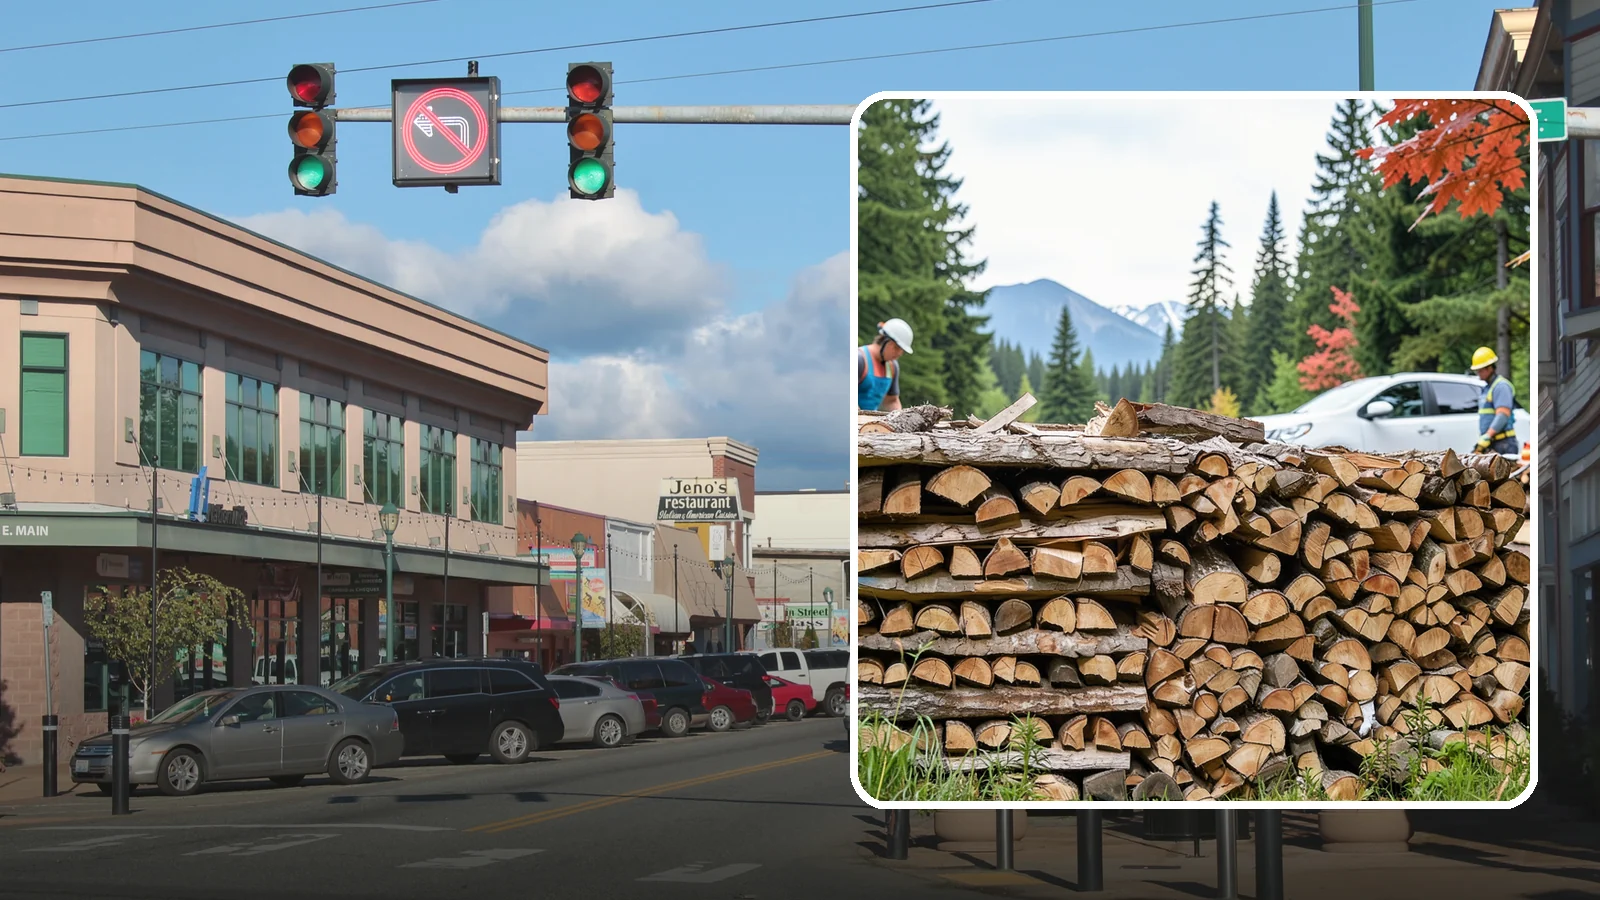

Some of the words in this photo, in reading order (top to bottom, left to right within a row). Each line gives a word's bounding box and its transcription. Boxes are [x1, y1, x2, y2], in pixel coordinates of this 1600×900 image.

[670, 480, 727, 494] Jeno's
[665, 496, 731, 509] restaurant
[658, 509, 681, 520] Italian
[685, 509, 715, 519] American
[715, 509, 737, 519] Cuisine
[2, 525, 13, 536] E.
[15, 525, 49, 536] MAIN
[797, 607, 829, 617] Street
[791, 619, 824, 627] lass
